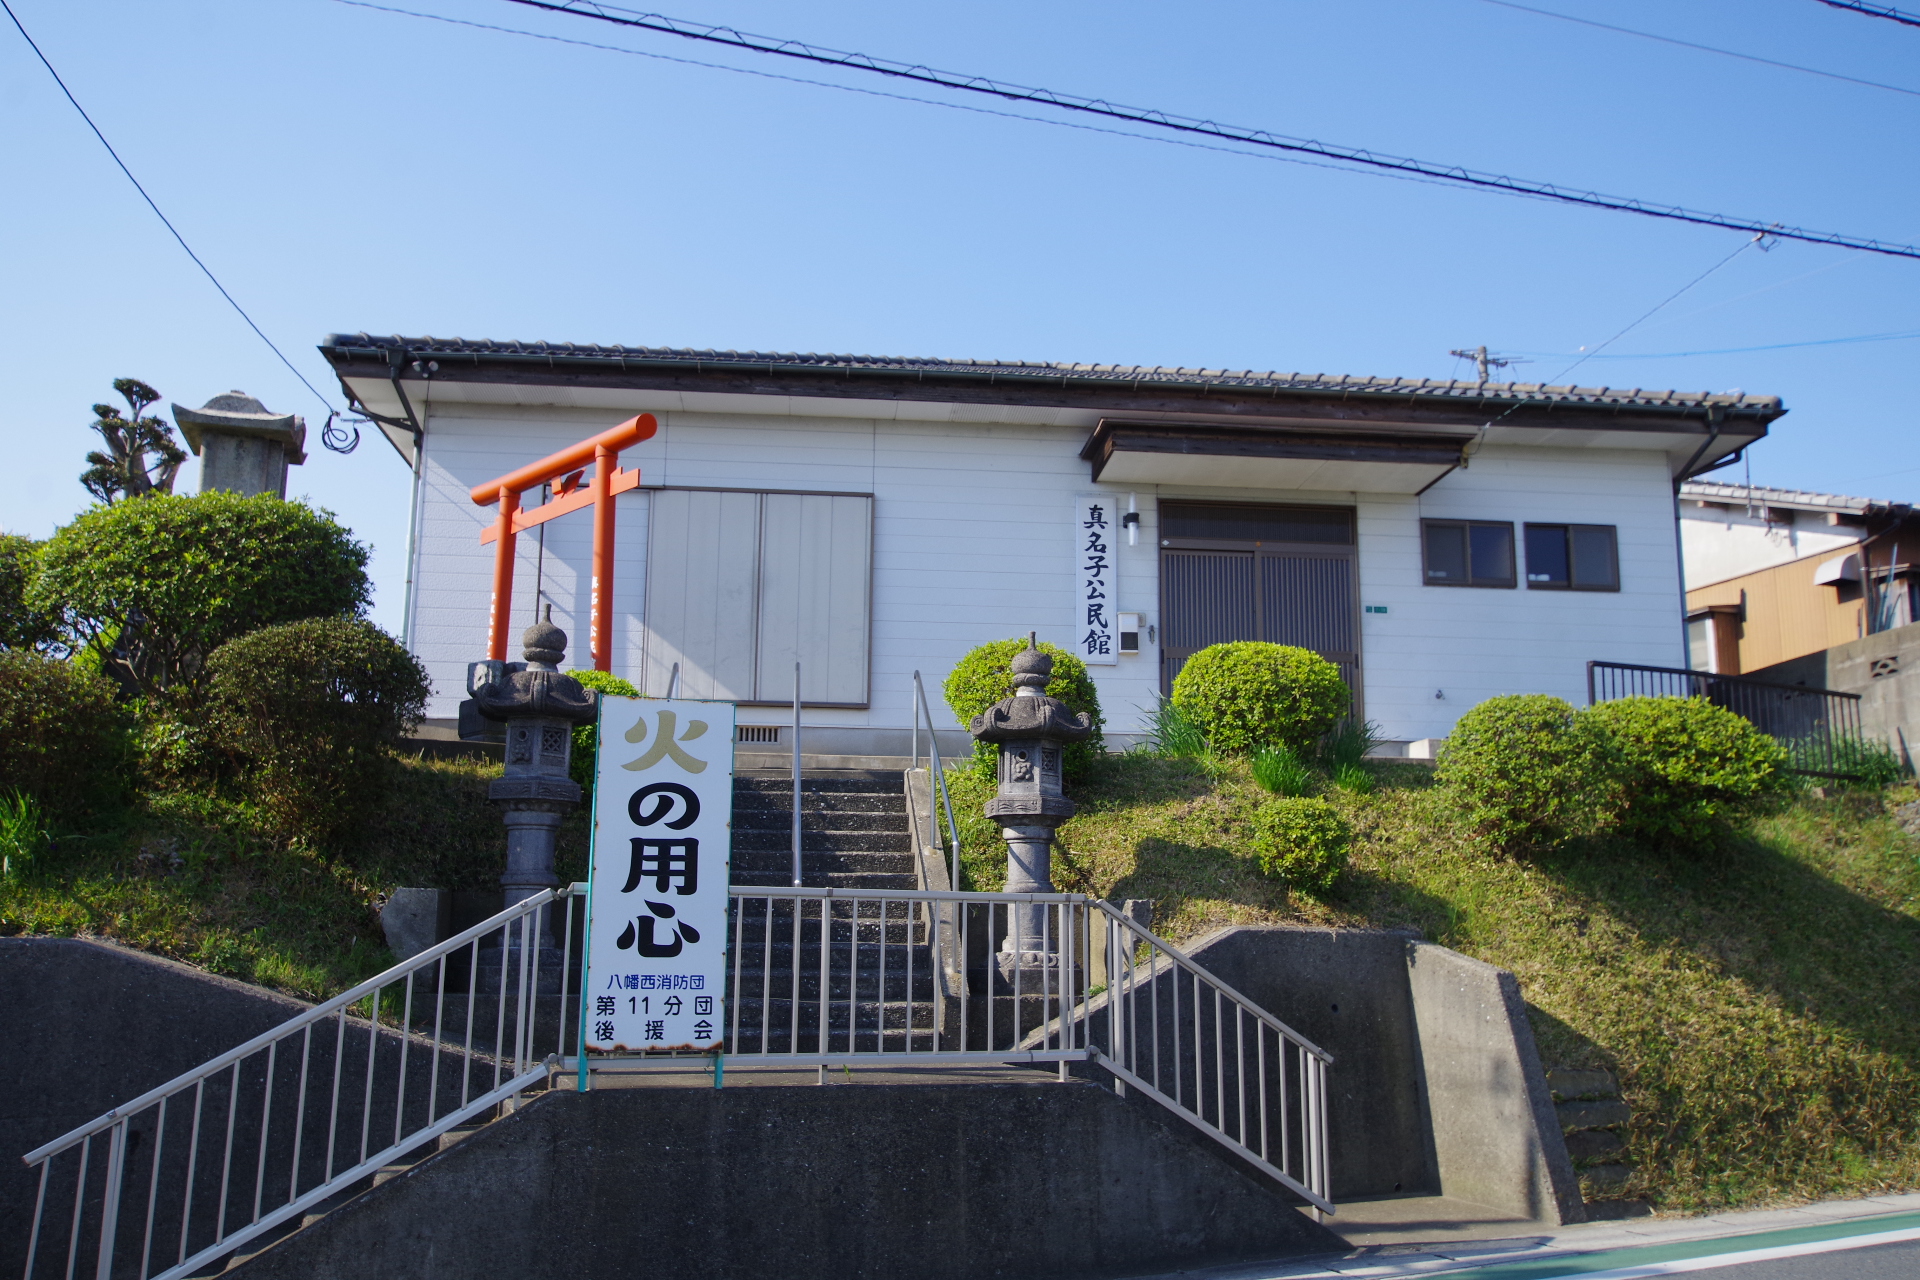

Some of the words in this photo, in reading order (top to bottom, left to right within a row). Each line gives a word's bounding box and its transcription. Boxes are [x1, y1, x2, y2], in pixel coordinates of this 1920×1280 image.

[1081, 504, 1112, 656] 真名子公民館
[616, 709, 709, 958] 火の用心
[606, 974, 705, 990] 八幡西消防団
[596, 995, 713, 1016] 第11分団
[594, 1019, 713, 1041] 後援会
